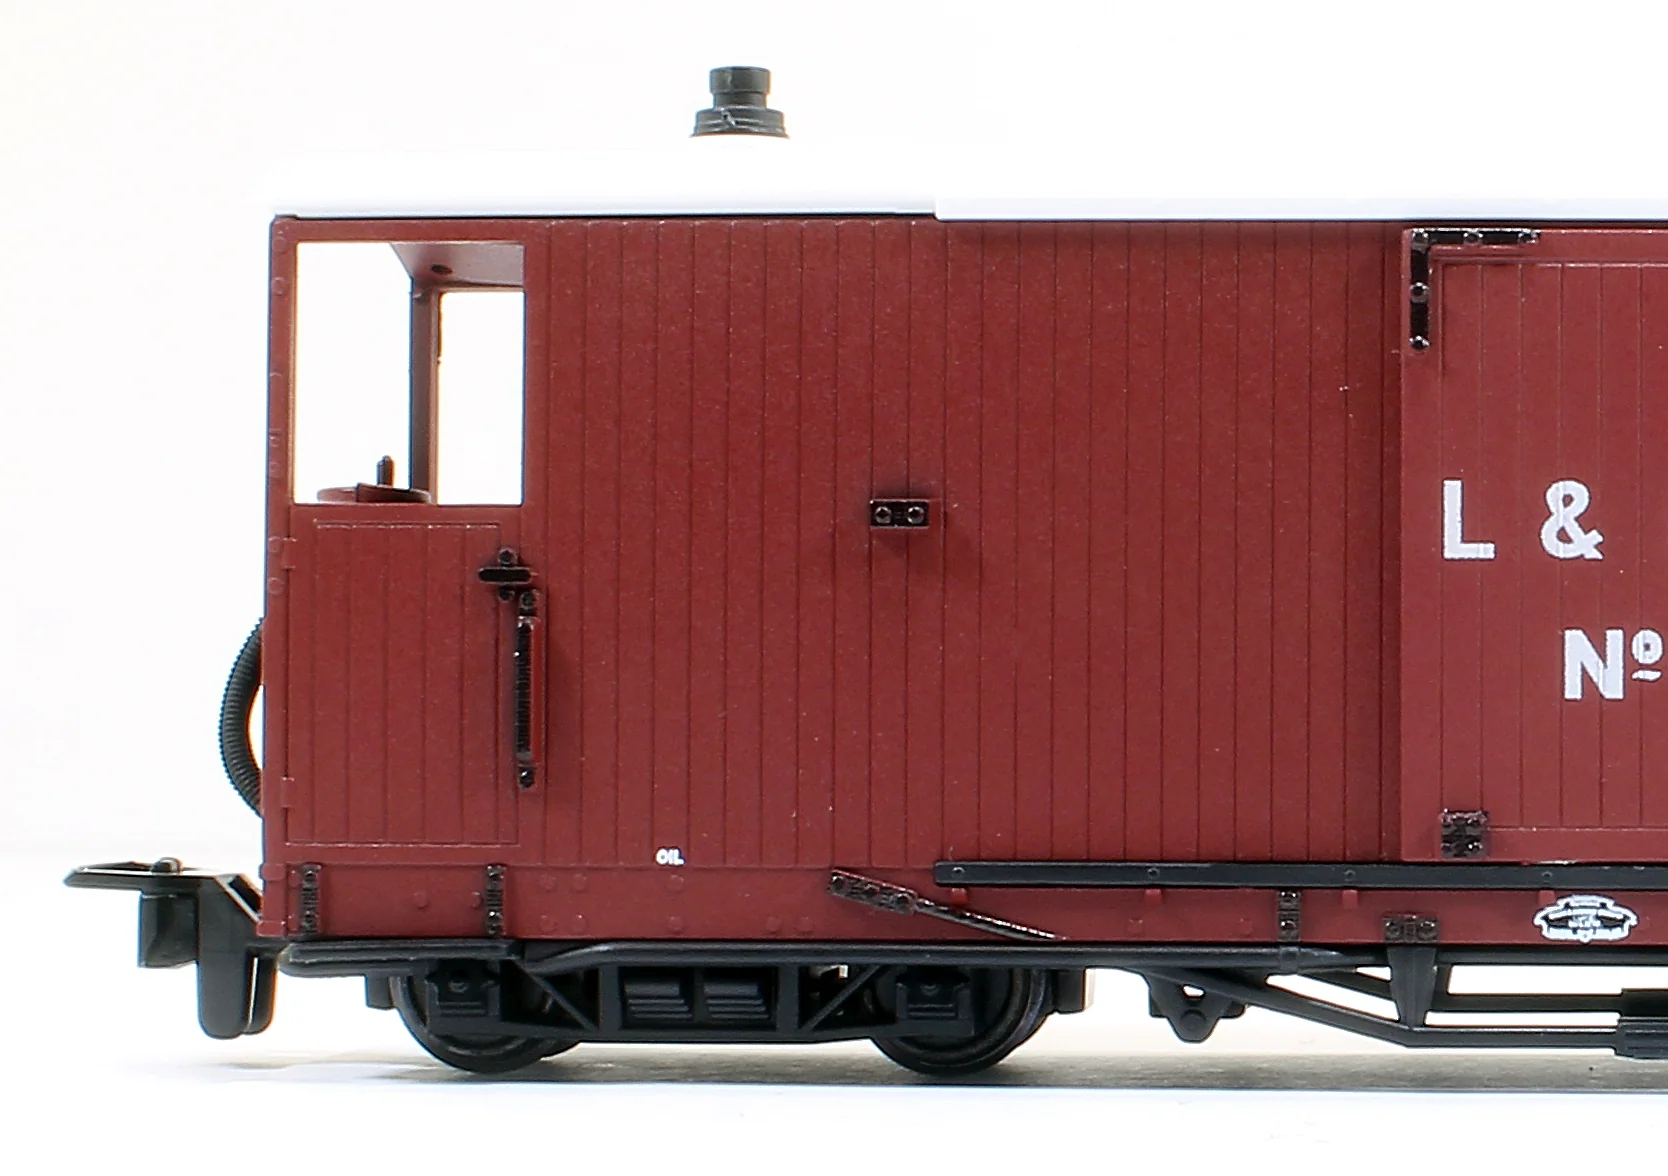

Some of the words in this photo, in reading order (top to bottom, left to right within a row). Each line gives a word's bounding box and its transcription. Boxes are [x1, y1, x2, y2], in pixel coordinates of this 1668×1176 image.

[1443, 479, 1496, 560] L
[1540, 480, 1604, 560] &
[655, 848, 685, 866] OIL
